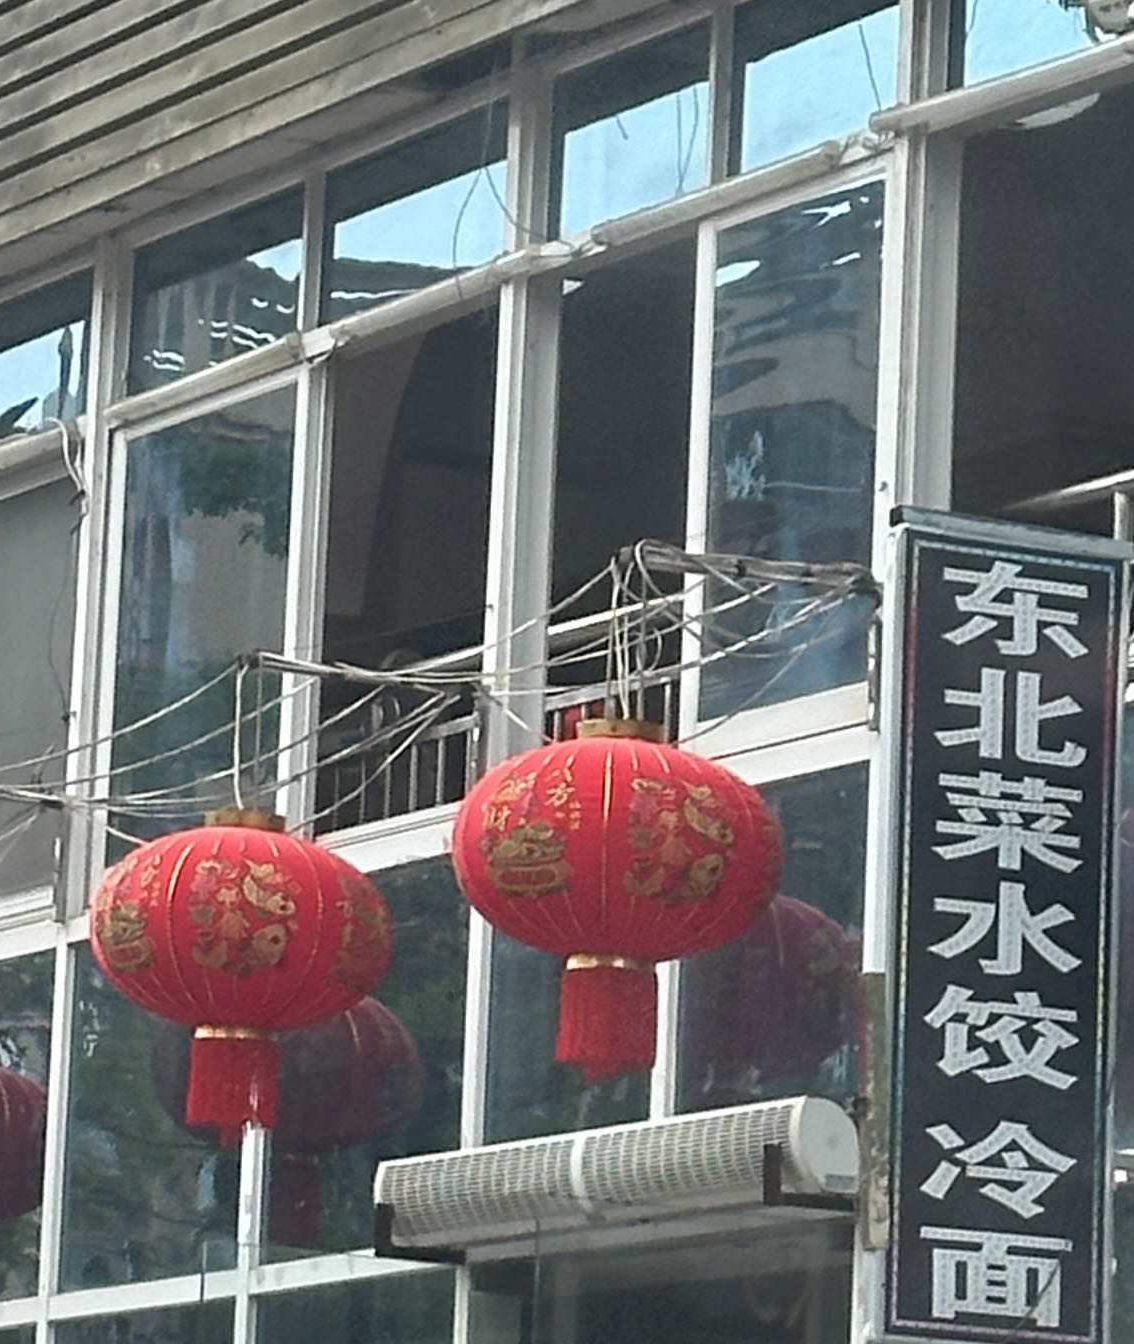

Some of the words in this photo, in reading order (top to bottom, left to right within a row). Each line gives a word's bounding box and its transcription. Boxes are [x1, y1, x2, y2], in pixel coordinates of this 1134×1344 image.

[918, 559, 1090, 1329] 东北菜水饺冷面
